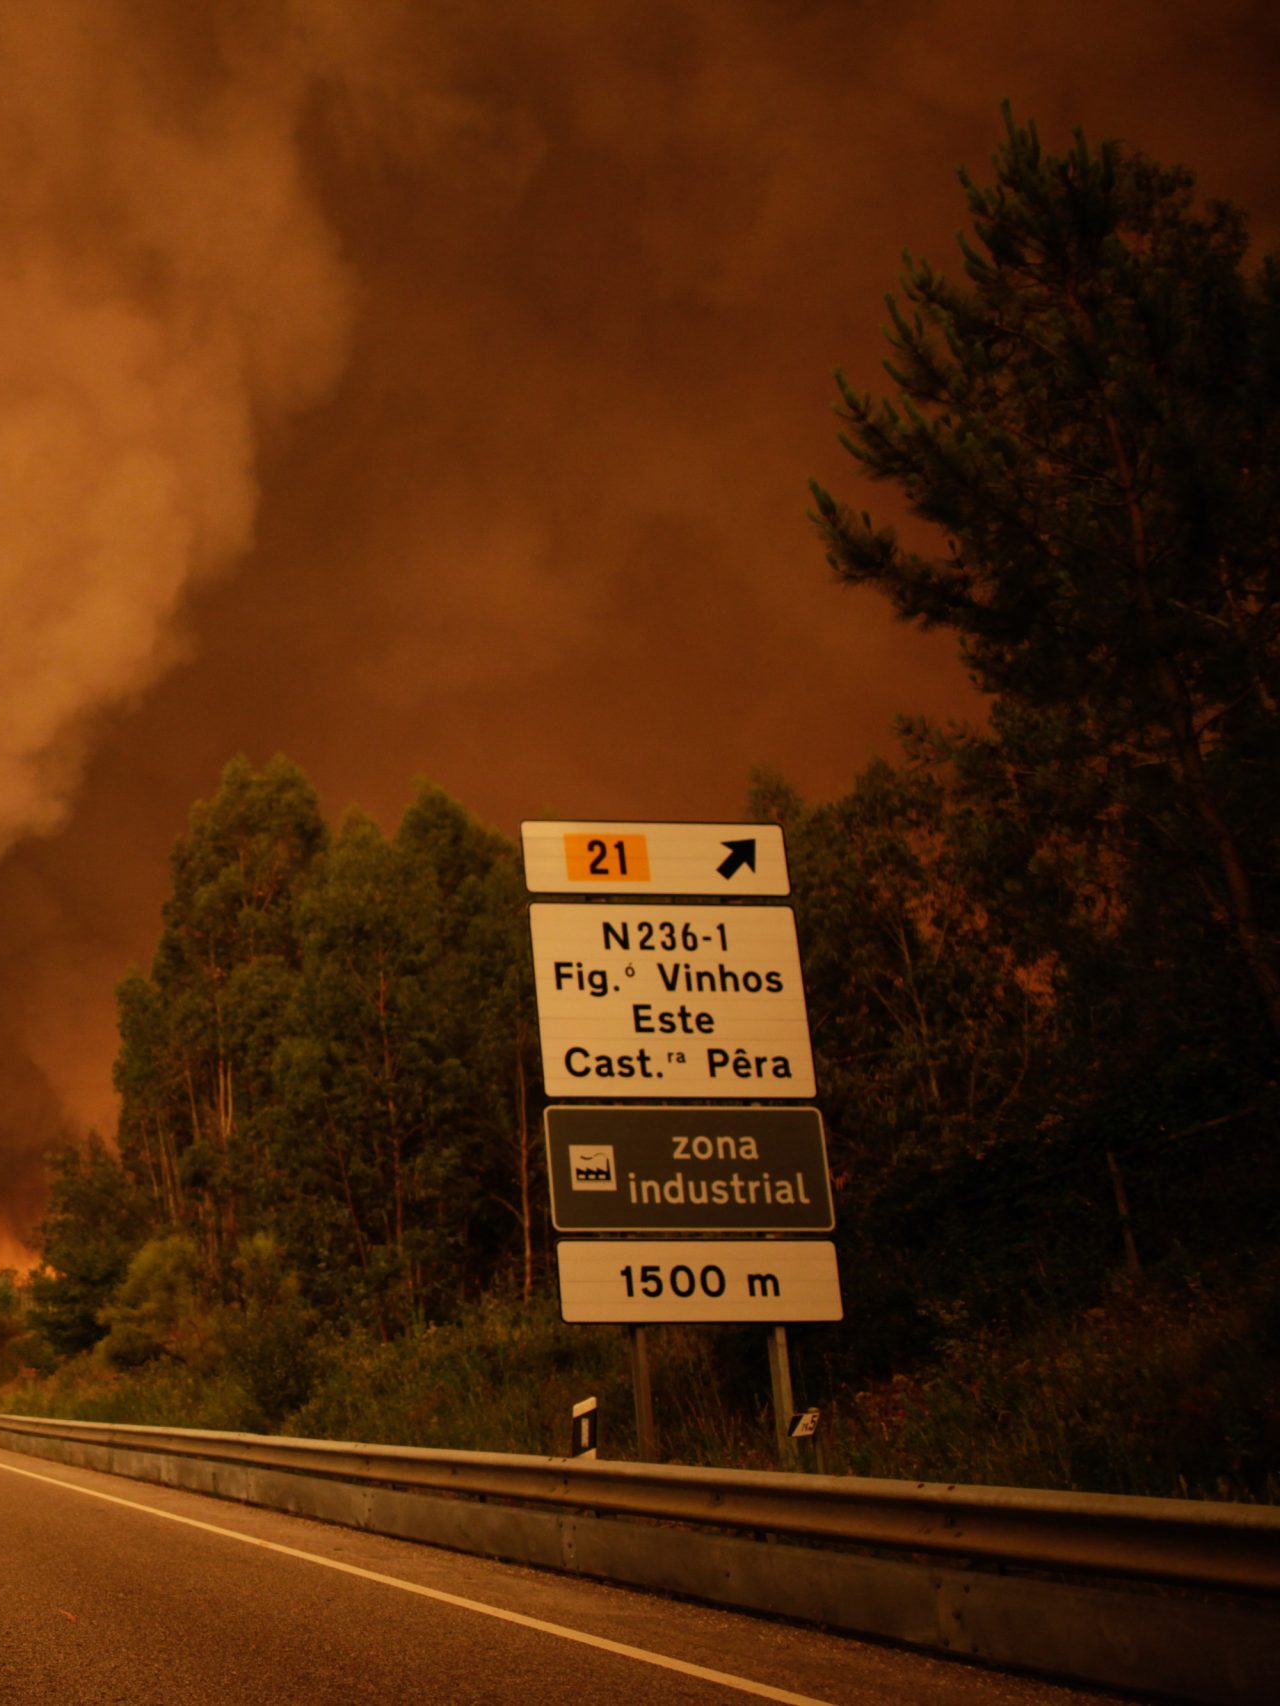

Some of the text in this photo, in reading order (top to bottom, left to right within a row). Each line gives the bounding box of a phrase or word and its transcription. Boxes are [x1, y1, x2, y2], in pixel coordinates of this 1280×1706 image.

[587, 840, 627, 875] 21
[658, 964, 783, 992] Vinhos
[633, 1004, 714, 1033] Este
[707, 1048, 792, 1078] Pêra
[672, 1135, 759, 1160] zona
[628, 1172, 811, 1205] industrial
[621, 1265, 780, 1297] 1500 m
